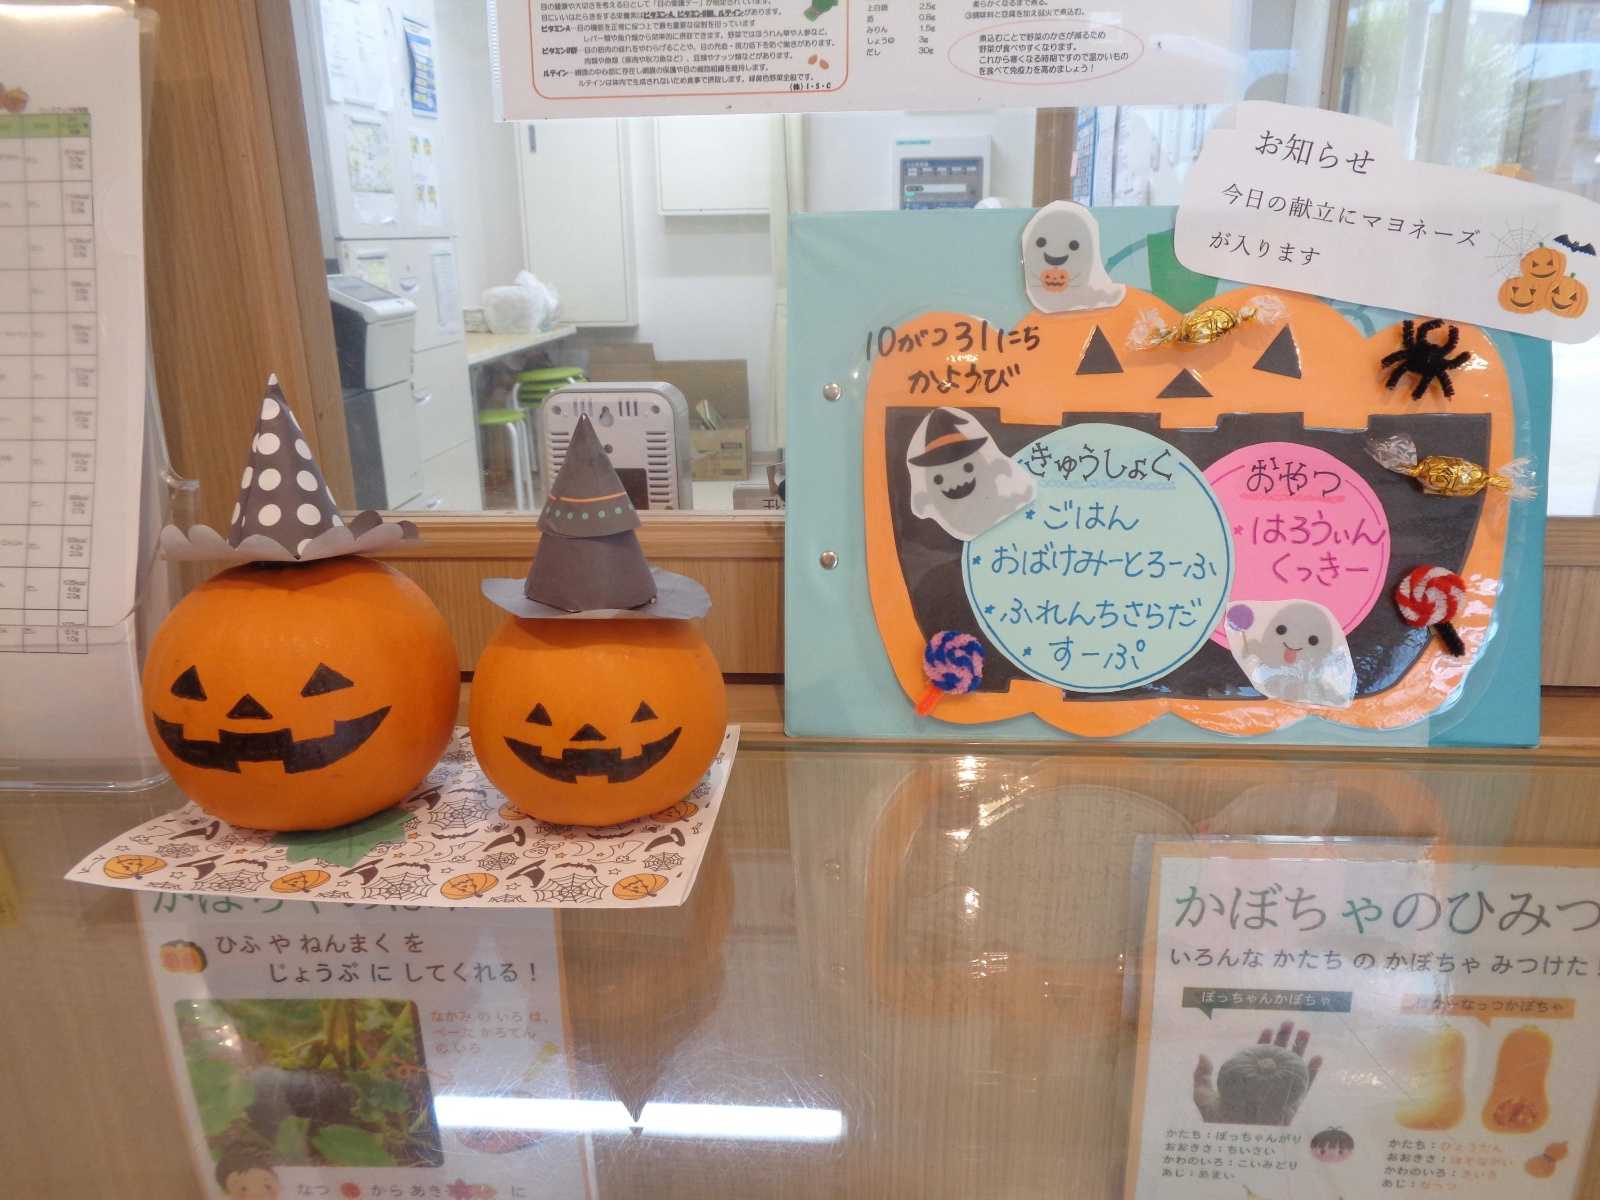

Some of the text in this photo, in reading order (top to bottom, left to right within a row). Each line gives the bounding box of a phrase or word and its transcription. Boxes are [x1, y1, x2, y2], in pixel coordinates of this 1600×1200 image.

[866, 26, 888, 34] みりん
[867, 37, 895, 45] しょうゆ
[978, 43, 1077, 53] 野菜が食べやすくなります。
[866, 47, 881, 56] だし
[1255, 129, 1376, 176] お知らせ
[1221, 182, 1481, 248] 今日の献立にマヨネーズ
[1207, 230, 1321, 267] が入ります
[866, 319, 1041, 361] 10がつ31にち
[907, 363, 1021, 395] かようび
[1025, 441, 1174, 482] きゅうしょく
[1245, 457, 1342, 497] おやつ
[1043, 501, 1141, 532] ごはん
[1251, 511, 1386, 547] はろうぃん
[991, 543, 1217, 580] おばけみーとろーふ
[1272, 552, 1370, 588] くっきー
[1000, 597, 1203, 631] ふれんちさらだ
[1048, 635, 1146, 671] すーぷ
[1174, 882, 1600, 937] かぼちゃのひみつ
[215, 933, 425, 955] ひふ や ねんまく を
[1170, 946, 1264, 969] いろんな
[1272, 948, 1344, 971] かたち
[1352, 952, 1376, 971] の
[1385, 952, 1481, 973] かぼちゃ
[269, 962, 361, 983] じょうぶ
[371, 965, 393, 983] に
